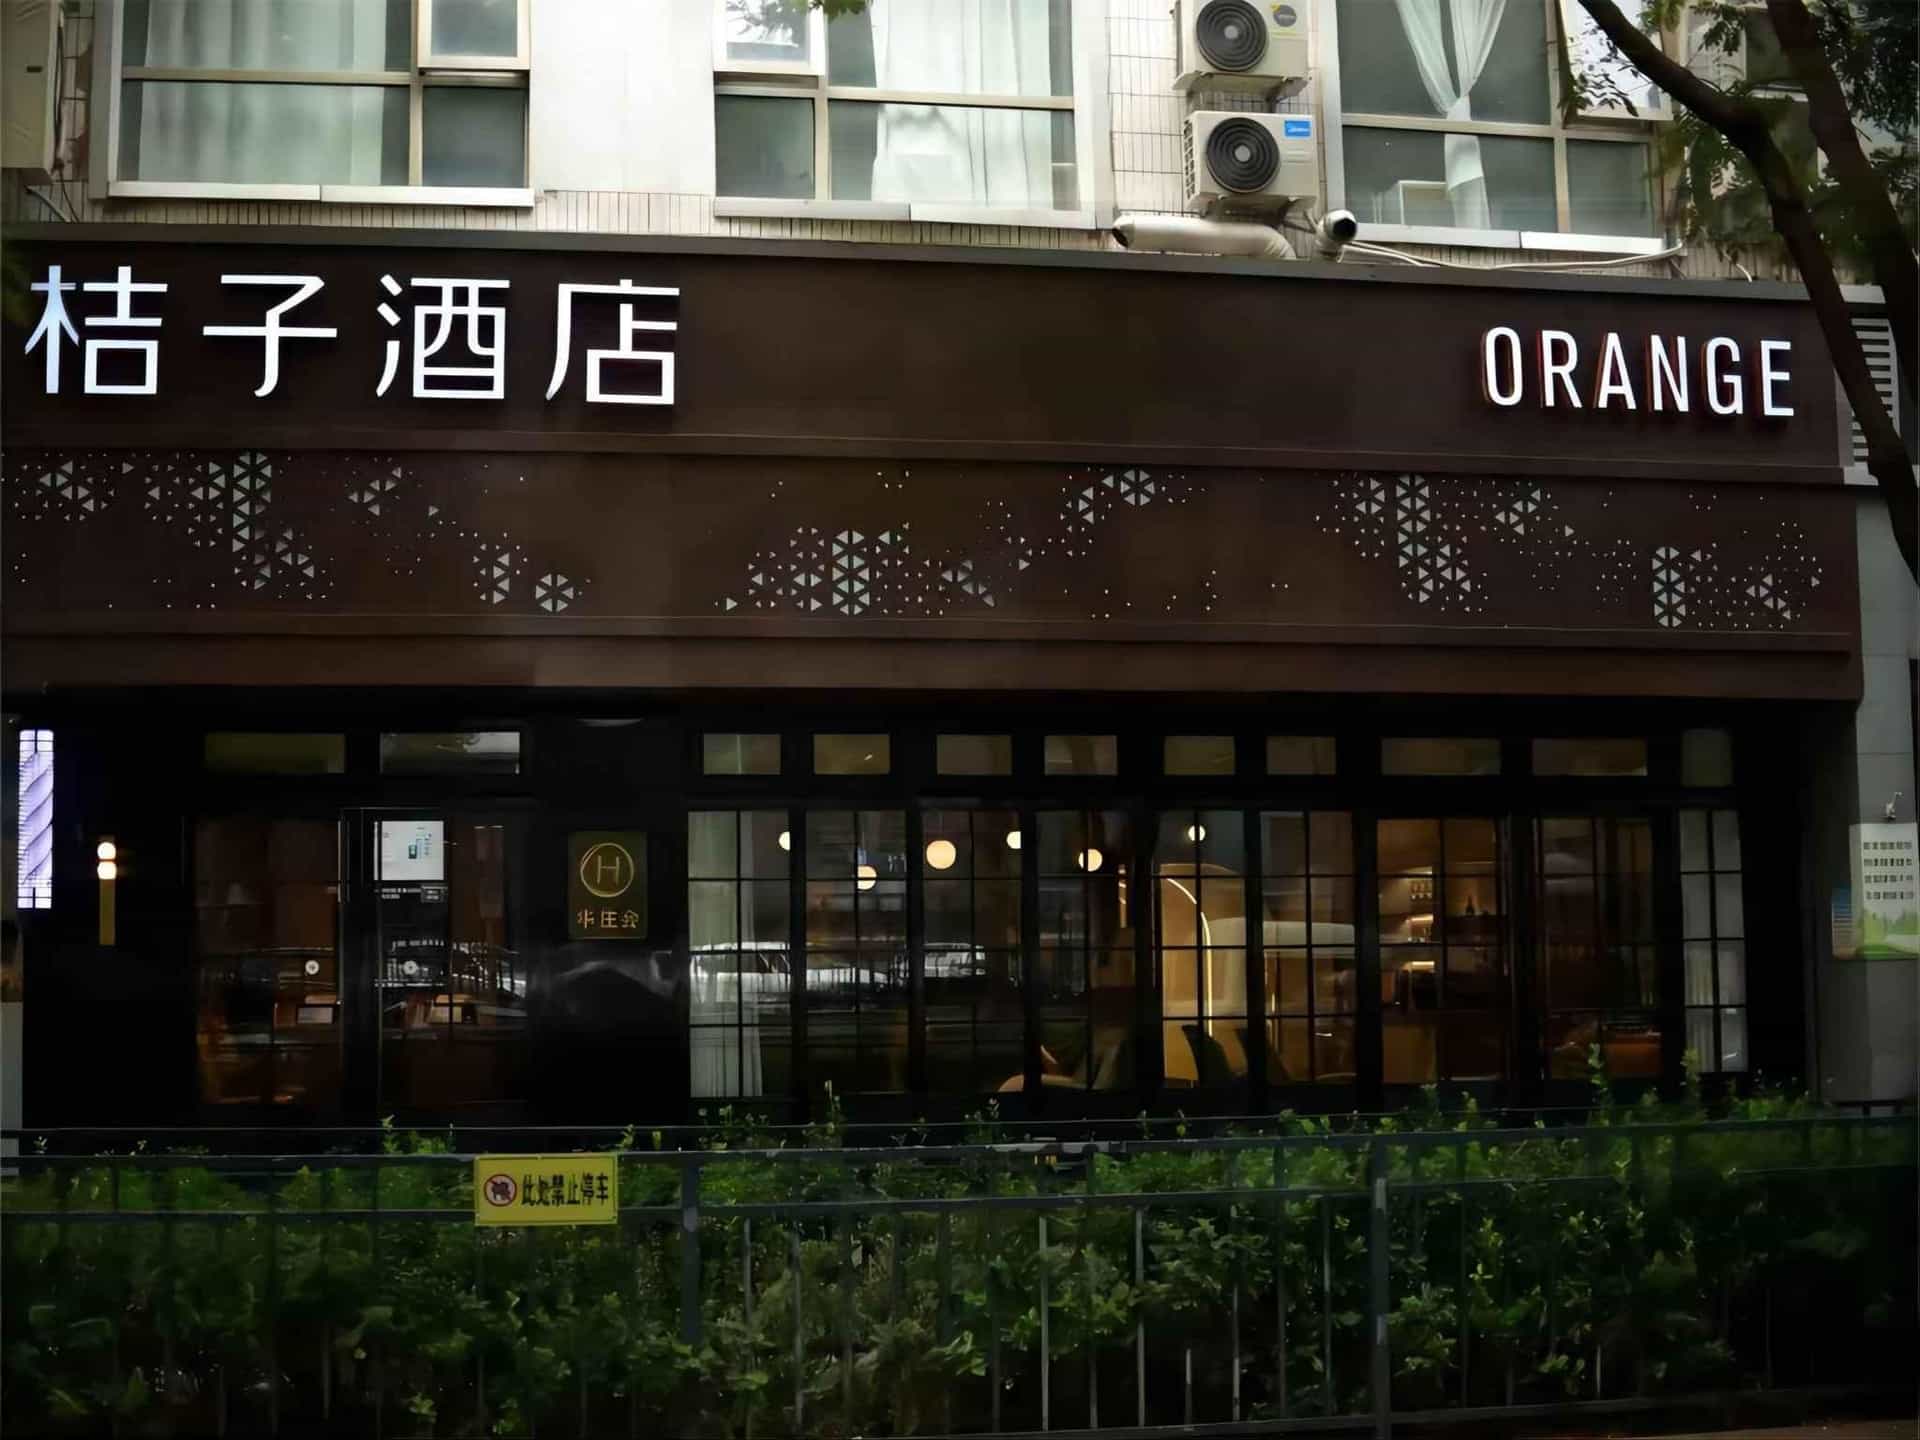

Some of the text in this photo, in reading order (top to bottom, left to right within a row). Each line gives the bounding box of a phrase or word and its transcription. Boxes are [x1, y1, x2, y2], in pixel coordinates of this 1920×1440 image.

[25, 265, 680, 405] 桔子酒店
[1482, 326, 1795, 417] ORANGE
[521, 1172, 609, 1207] 此处禁止停车
